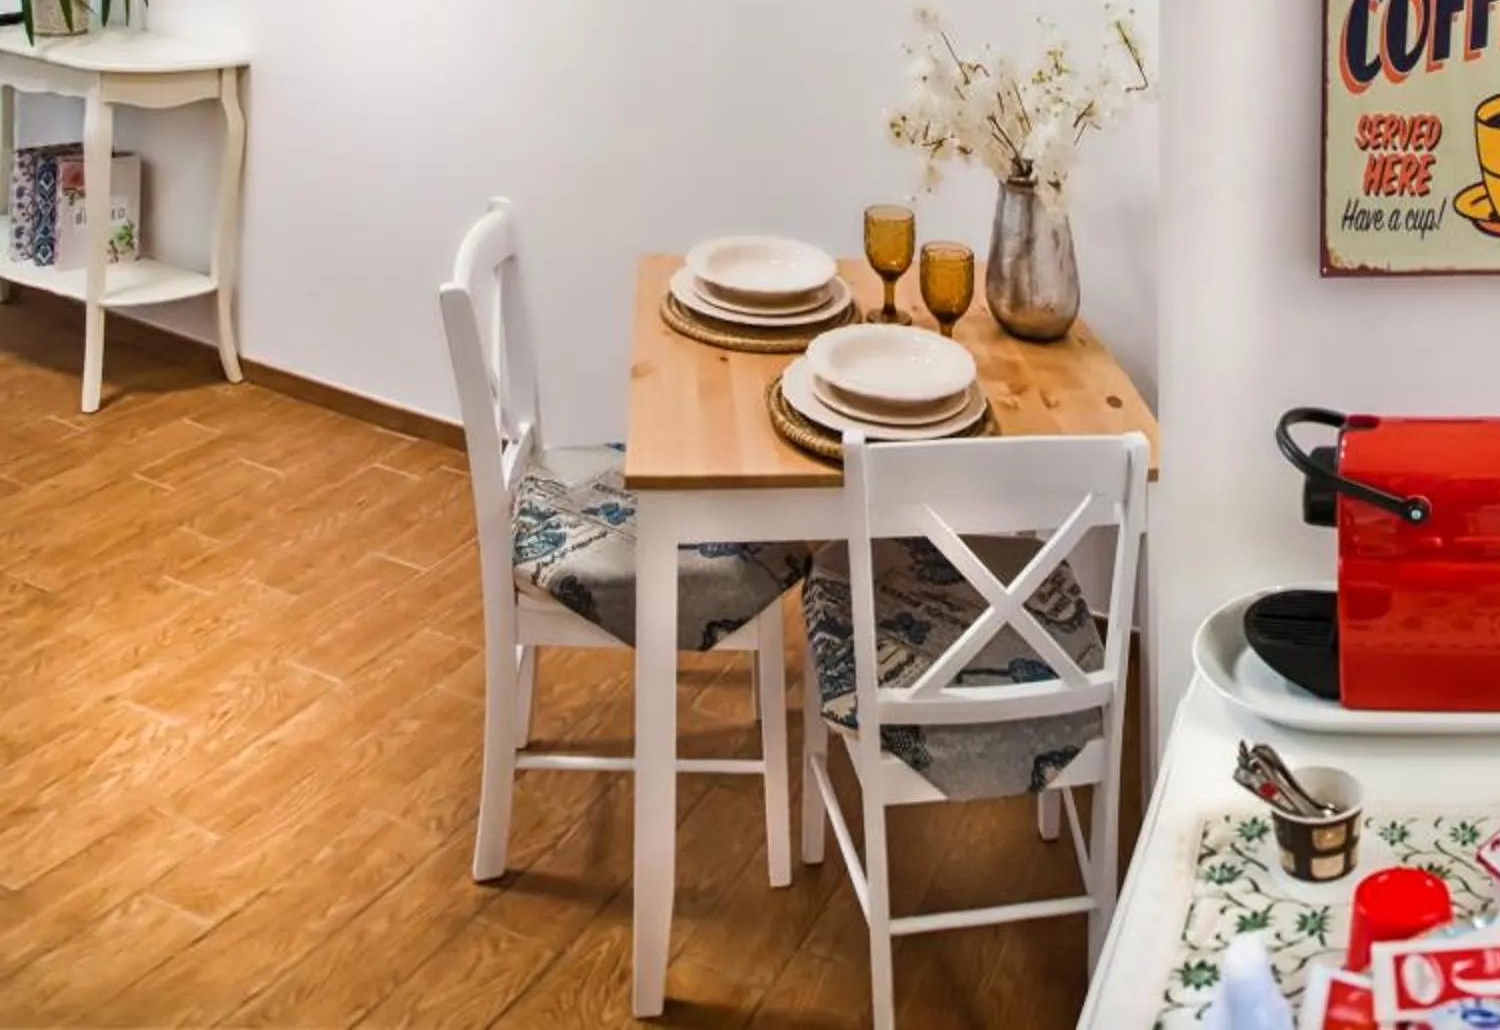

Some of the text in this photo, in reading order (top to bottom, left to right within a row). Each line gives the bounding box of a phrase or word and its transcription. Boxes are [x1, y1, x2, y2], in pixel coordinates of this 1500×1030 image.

[1355, 114, 1442, 151] SERVED
[1363, 153, 1436, 197] HERE
[1341, 198, 1447, 240] Have a cup!
